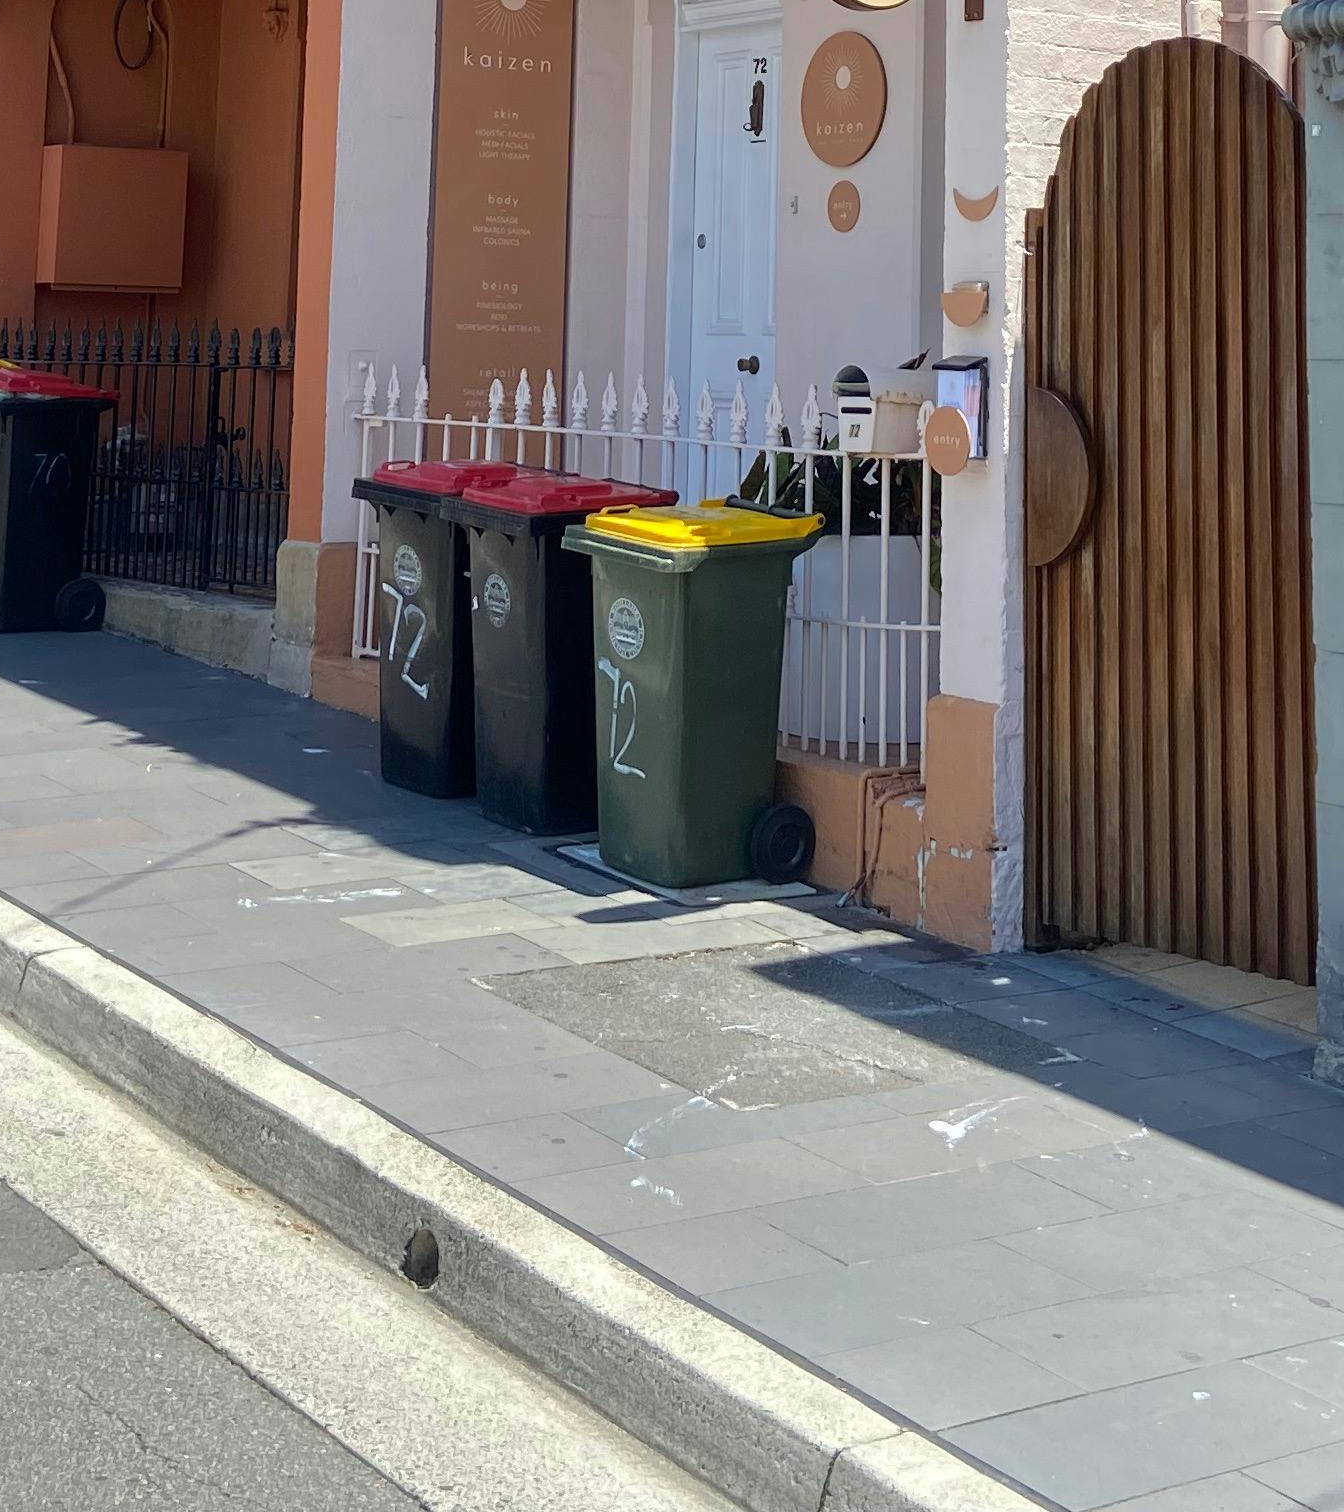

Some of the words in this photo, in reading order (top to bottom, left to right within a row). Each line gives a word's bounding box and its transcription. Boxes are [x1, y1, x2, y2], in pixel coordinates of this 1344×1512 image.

[463, 45, 553, 73] kaizen
[752, 56, 768, 75] 72
[493, 108, 520, 121] skin
[816, 119, 864, 136] kaizen
[487, 193, 519, 208] body
[481, 279, 519, 295] being
[933, 434, 961, 450] entry
[381, 582, 430, 700] 72
[598, 656, 646, 779] 72
